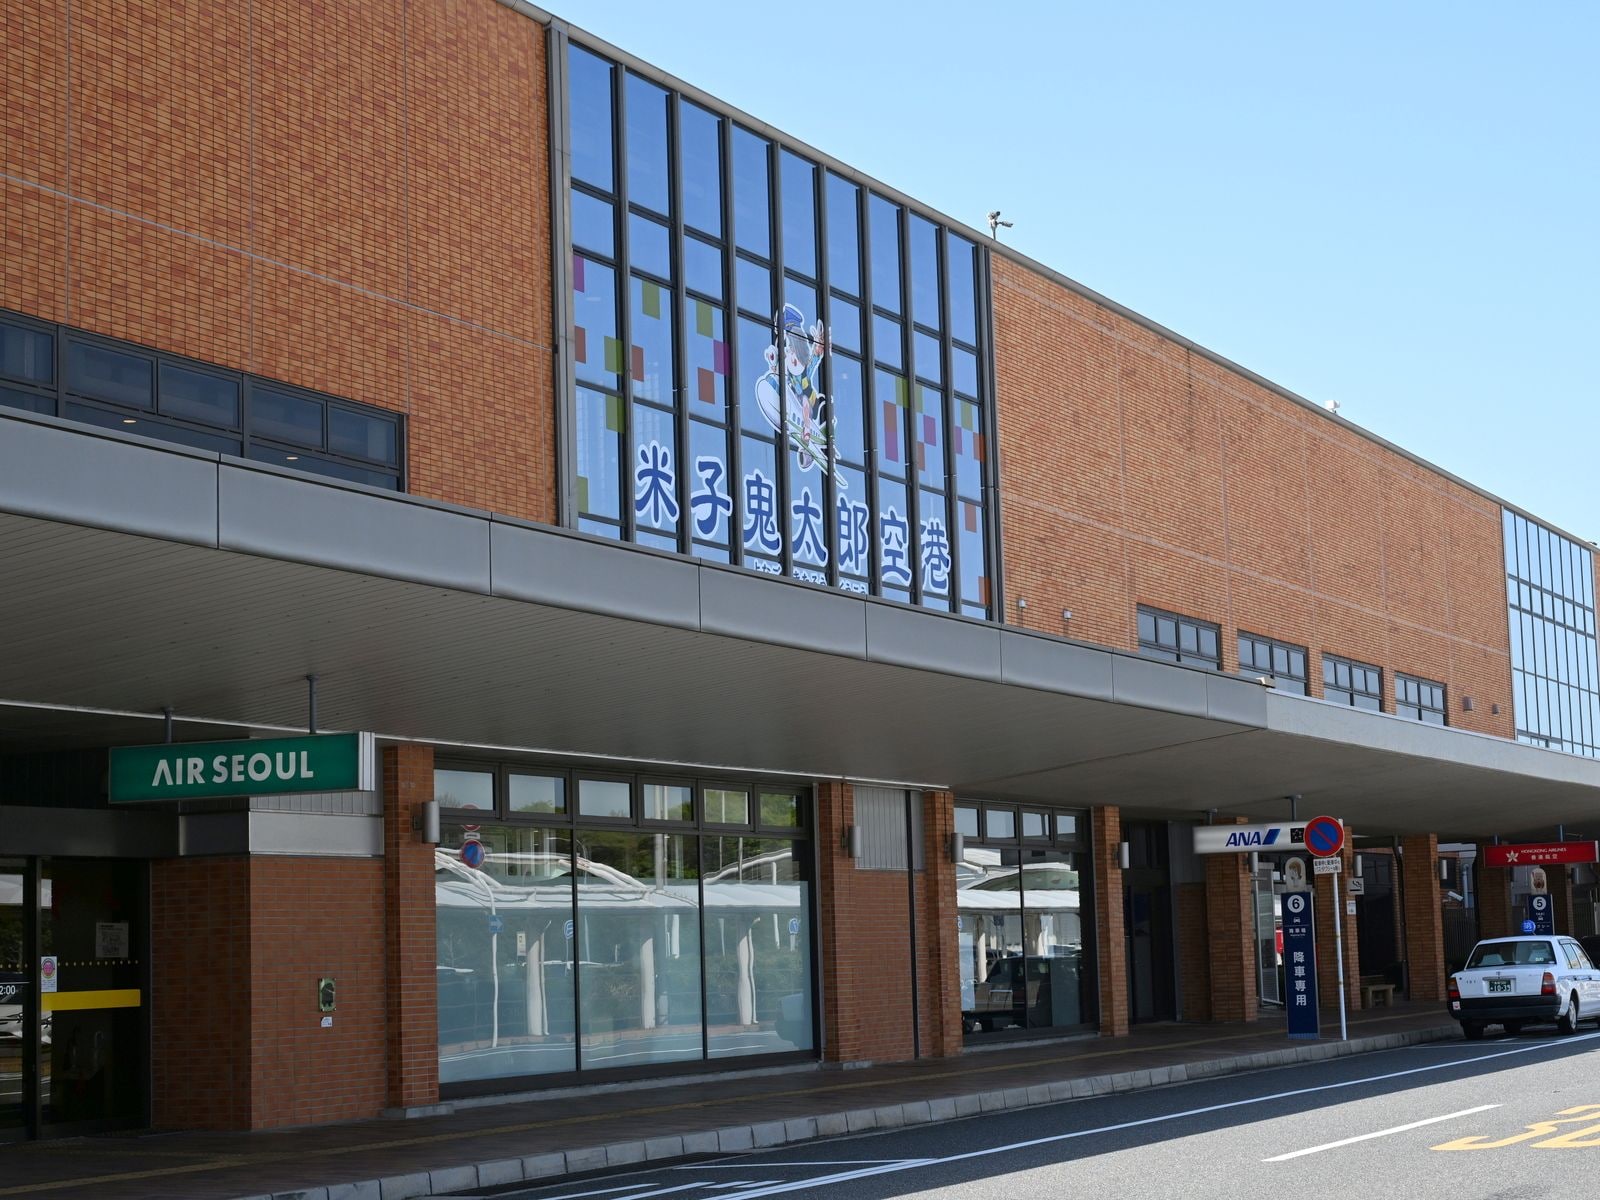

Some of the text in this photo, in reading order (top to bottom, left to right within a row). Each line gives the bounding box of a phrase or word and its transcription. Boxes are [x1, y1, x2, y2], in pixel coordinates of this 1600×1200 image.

[635, 443, 951, 592] 米子鬼太郎空港
[152, 750, 314, 787] AIR SEOUL
[1225, 831, 1261, 847] ANA
[1292, 898, 1300, 910] 6
[1536, 898, 1543, 908] 5
[1293, 951, 1307, 1006] 降車専用
